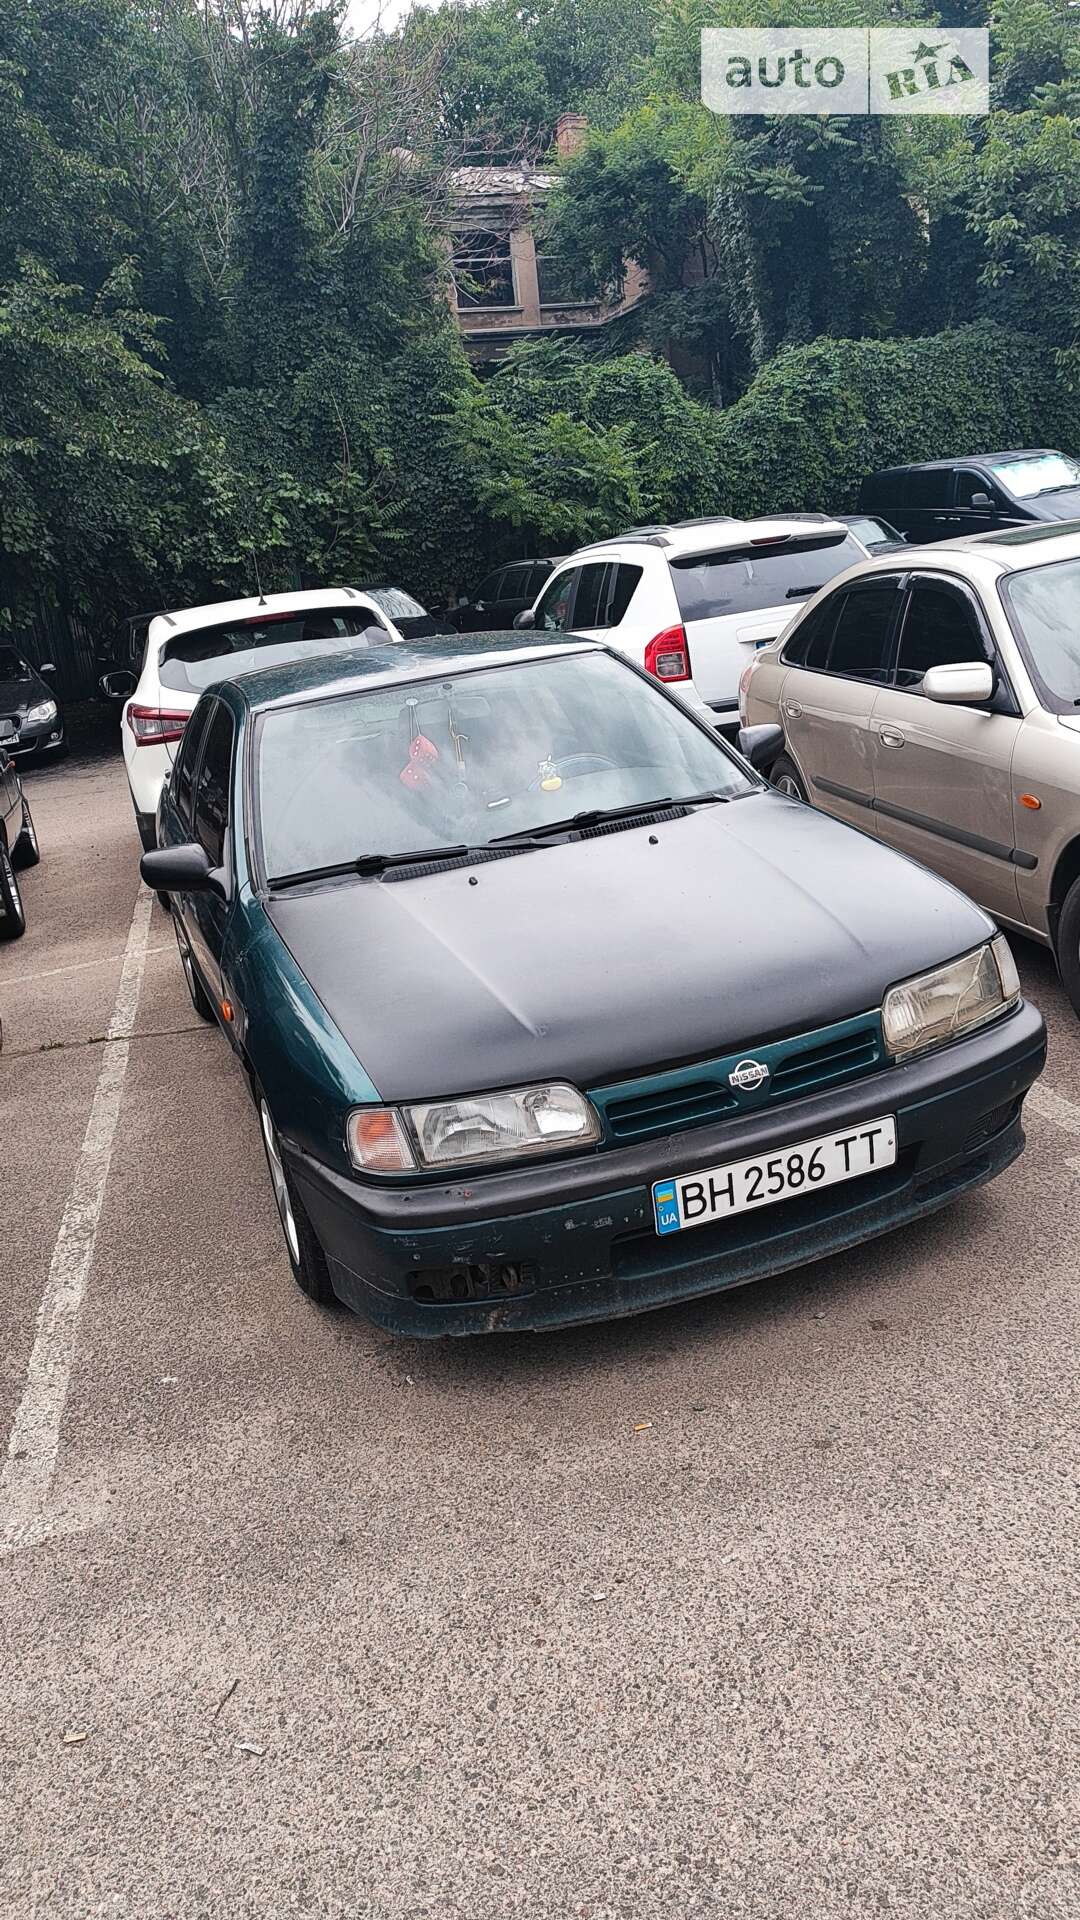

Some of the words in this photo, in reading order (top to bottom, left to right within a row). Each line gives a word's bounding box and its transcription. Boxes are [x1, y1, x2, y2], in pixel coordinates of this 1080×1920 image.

[731, 1066, 768, 1083] NISSAN
[681, 1172, 735, 1220] BH
[744, 1146, 826, 1203] 2586
[834, 1128, 882, 1172] TT
[661, 1212, 678, 1226] UA
